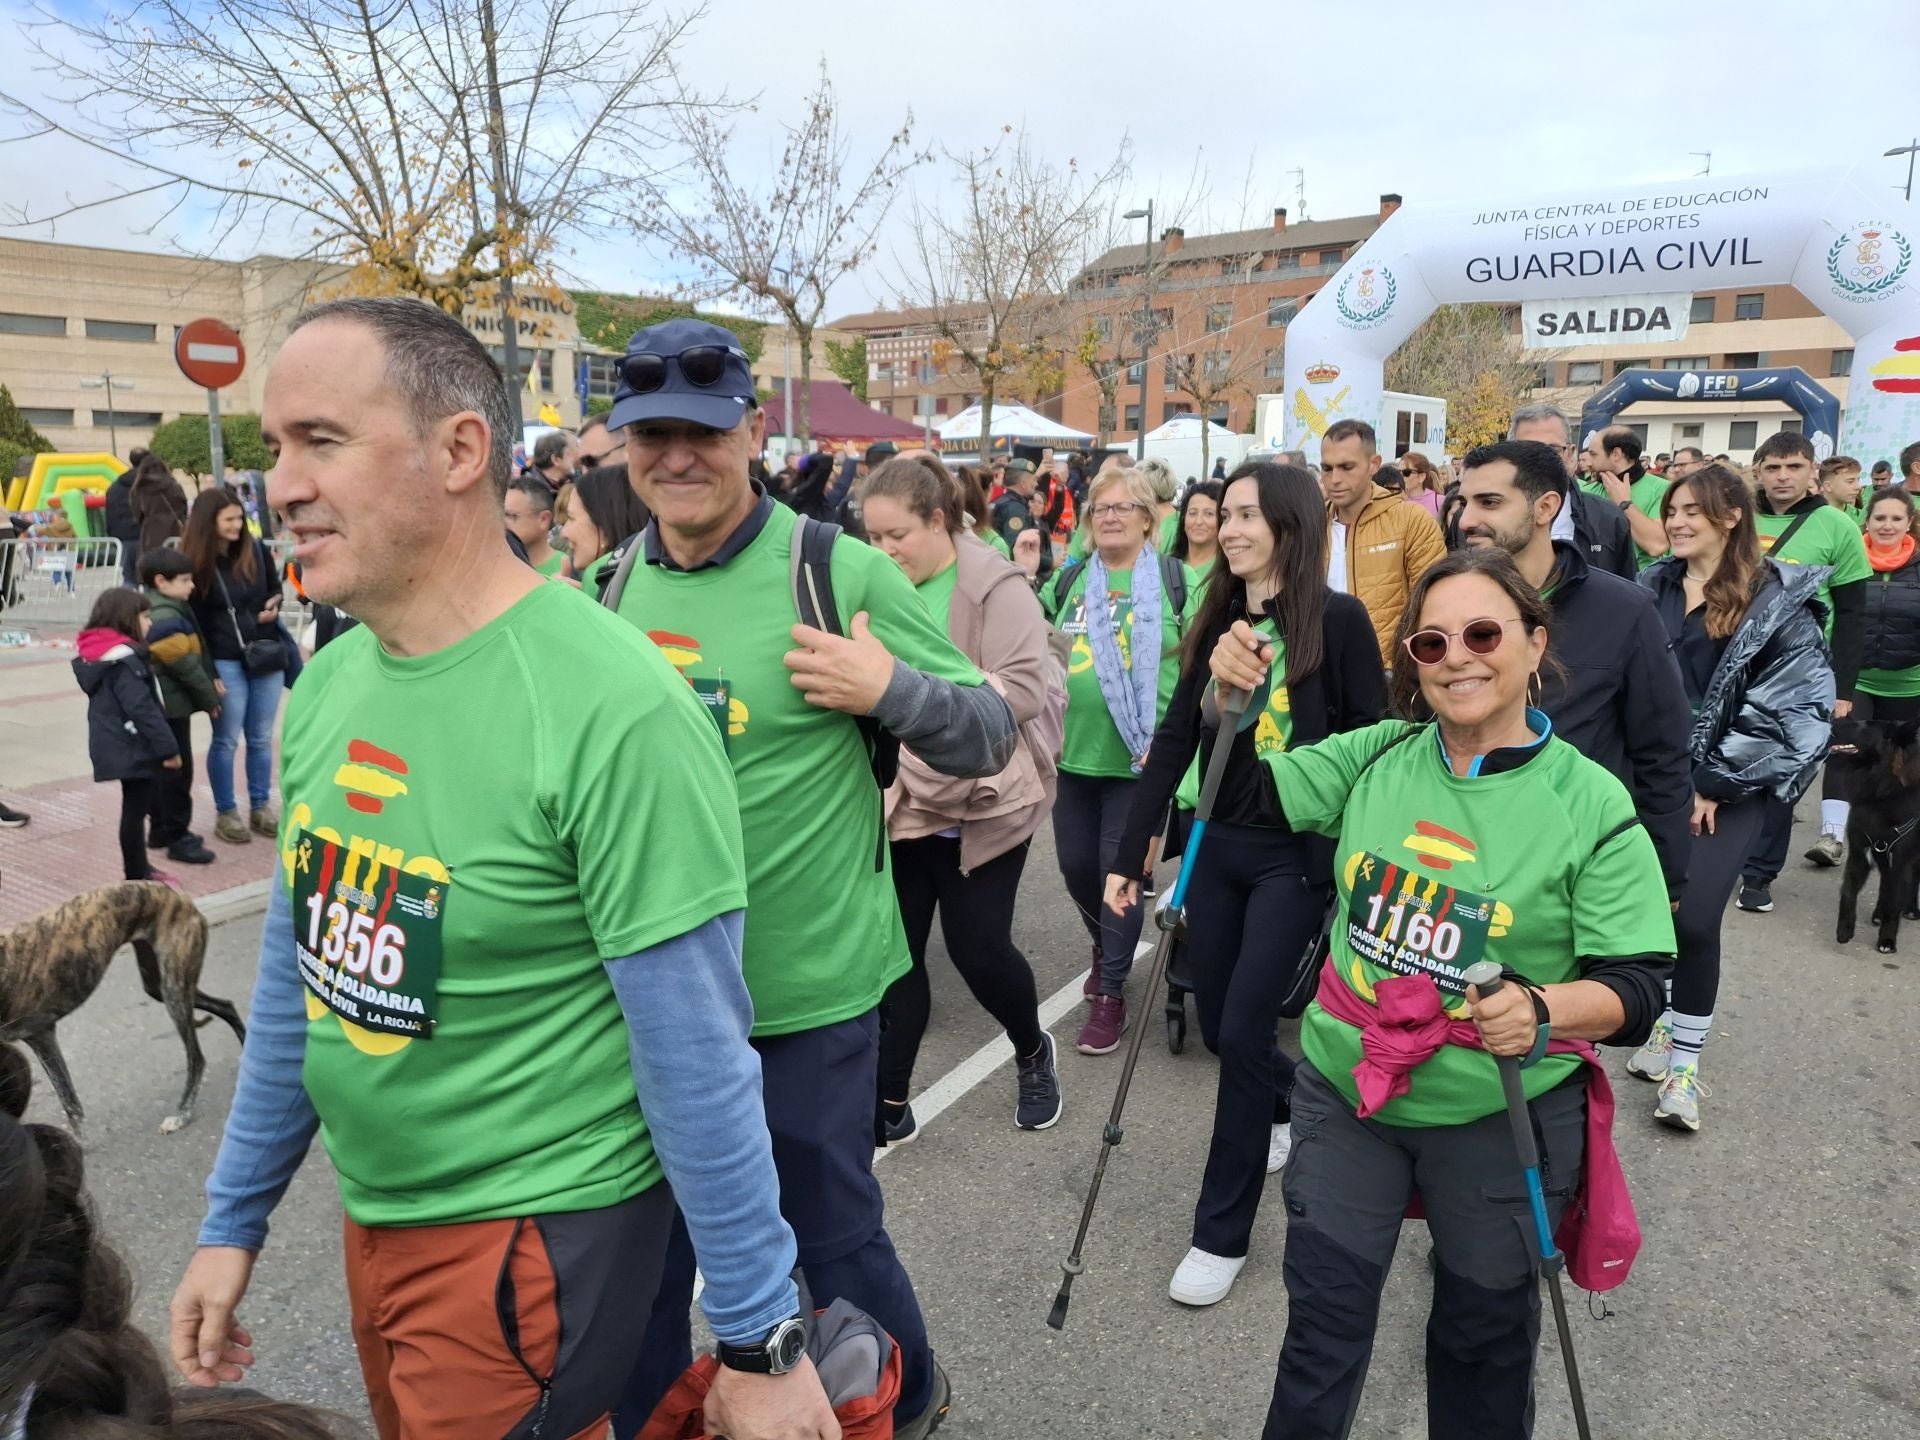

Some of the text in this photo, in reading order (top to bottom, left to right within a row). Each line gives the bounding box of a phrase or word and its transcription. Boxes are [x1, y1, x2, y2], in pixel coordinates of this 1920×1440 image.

[1471, 187, 1769, 226] JUNTA CENTRAL DE EDUCACIÓN
[1524, 213, 1701, 241] FÍSICA Y DEPORTES
[1465, 236, 1763, 283] GUARDIA CIVIL
[1830, 283, 1907, 304] GUARDIA CIVIL
[1336, 312, 1395, 332] GUARDIA CIVIL
[1536, 306, 1673, 337] SALIDA
[1703, 375, 1740, 391] FFD
[961, 437, 981, 450] CIV
[1398, 889, 1433, 912] BEATRIZ
[306, 891, 407, 986] 1356
[1352, 925, 1396, 957] CARRERA
[1366, 893, 1462, 961] 1160
[1350, 937, 1389, 966] GUARDIA
[1439, 980, 1466, 993] RIOJ
[334, 971, 426, 1015] SOLIDARIA
[330, 991, 361, 1018] CIVIL
[366, 1011, 382, 1025] LA
[383, 1015, 423, 1033] RIOJA
